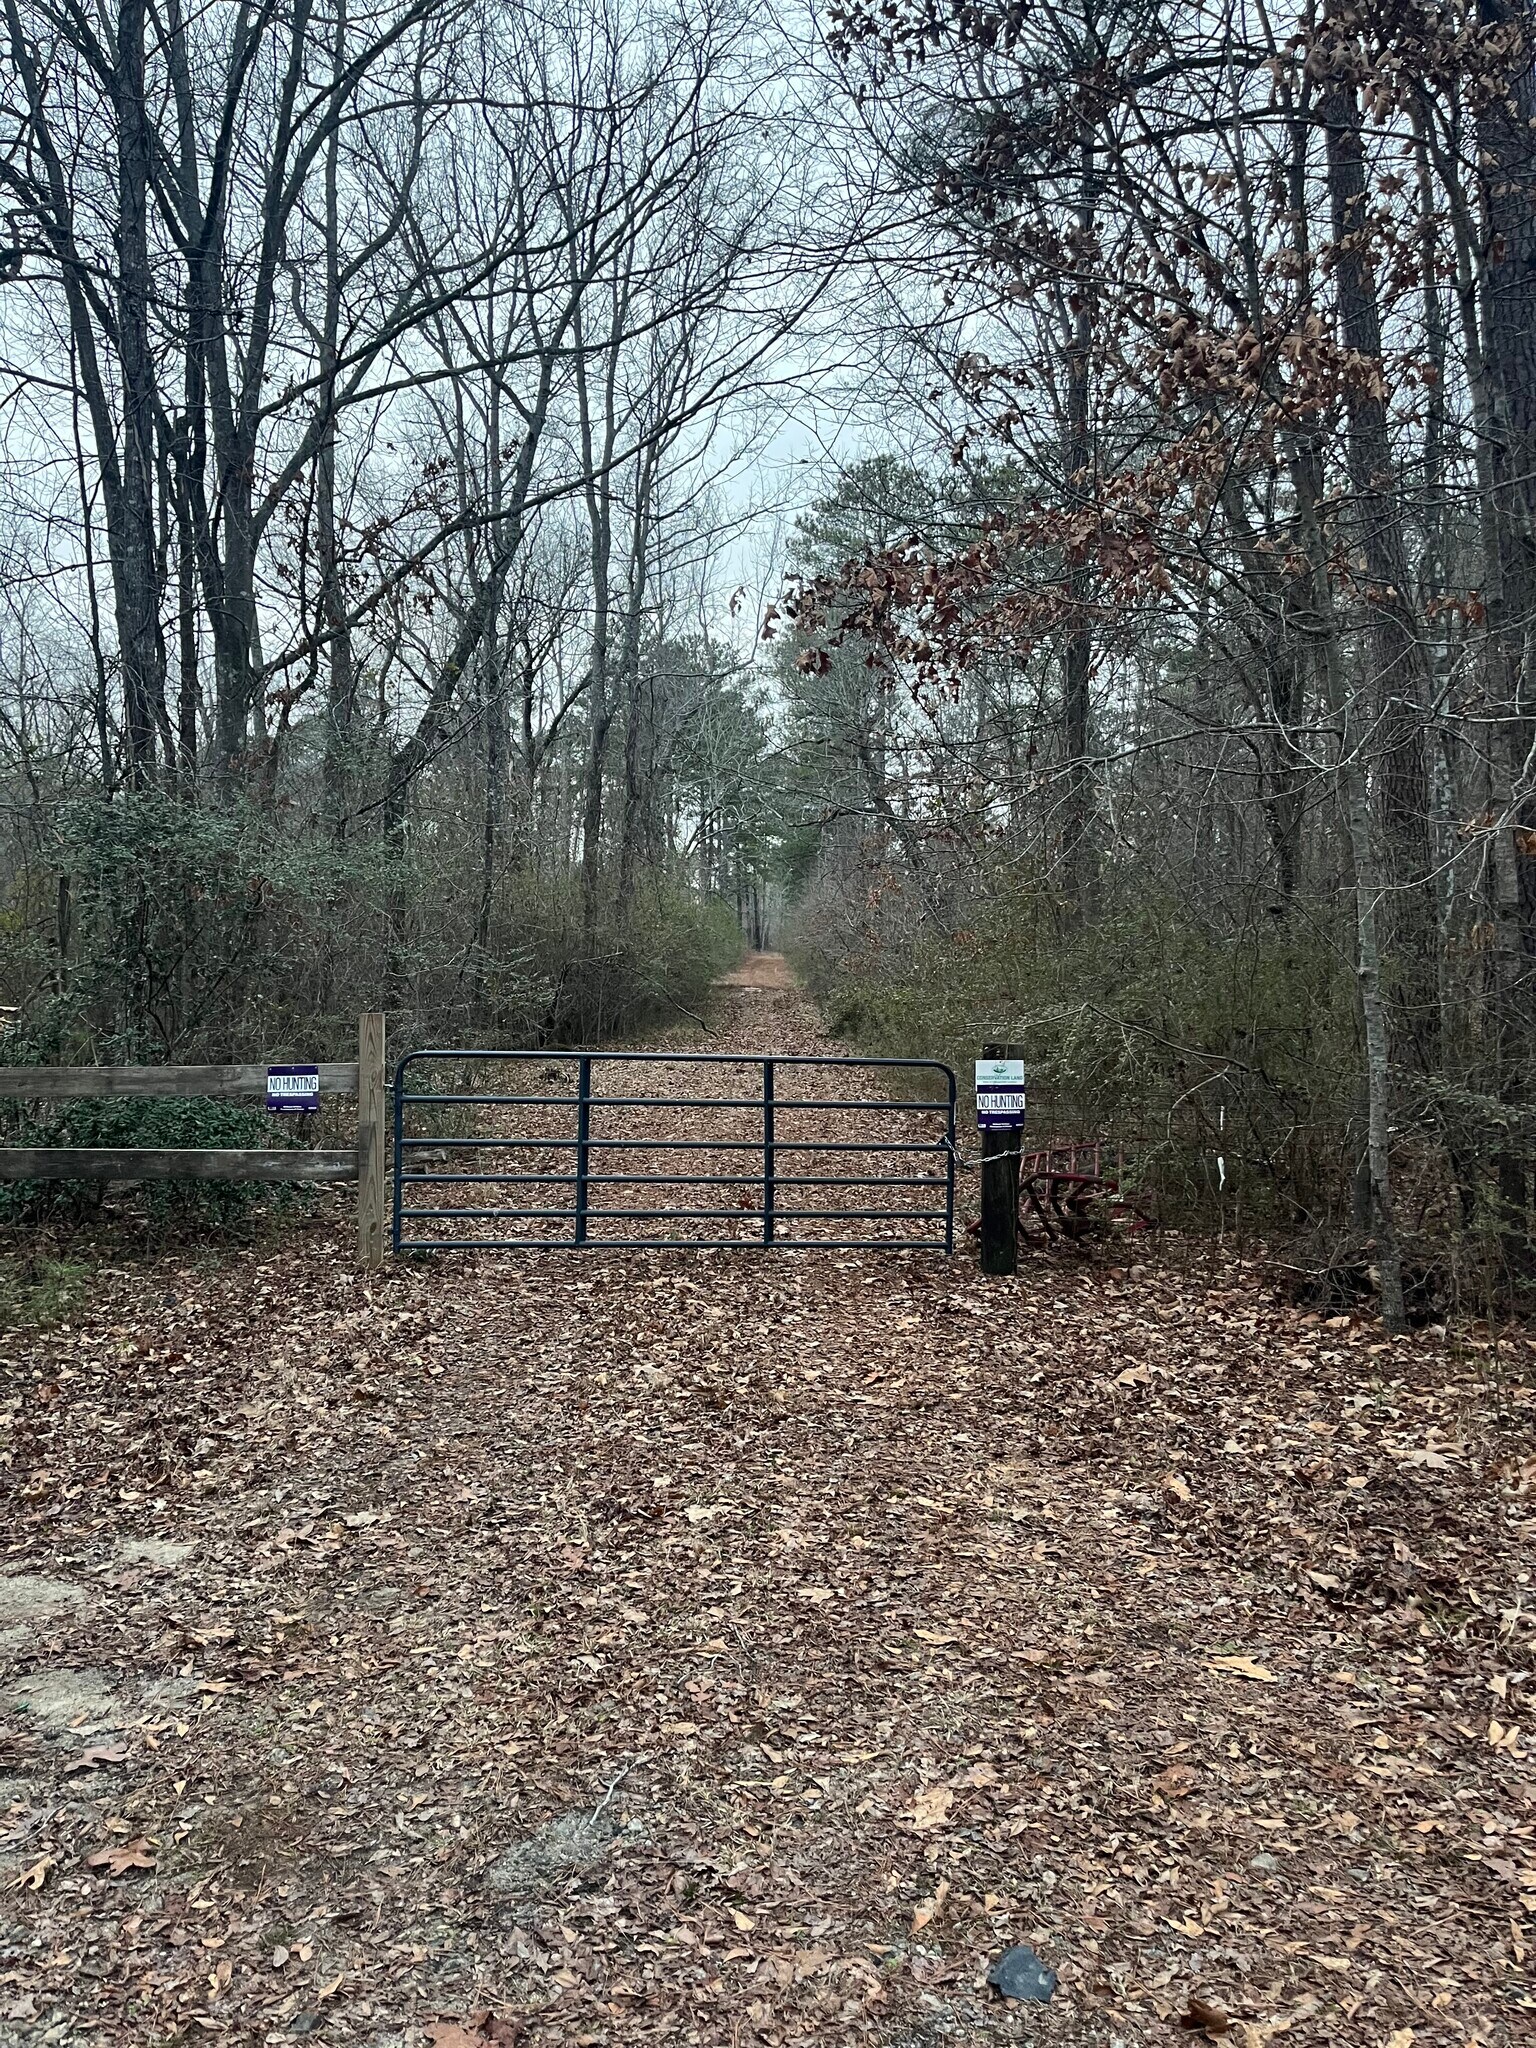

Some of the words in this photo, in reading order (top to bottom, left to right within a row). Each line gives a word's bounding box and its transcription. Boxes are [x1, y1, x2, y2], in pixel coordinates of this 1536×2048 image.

[269, 1077, 281, 1091] NO
[283, 1076, 317, 1091] HUNTING
[978, 1094, 989, 1108] NO
[991, 1094, 1023, 1108] HUNTING
